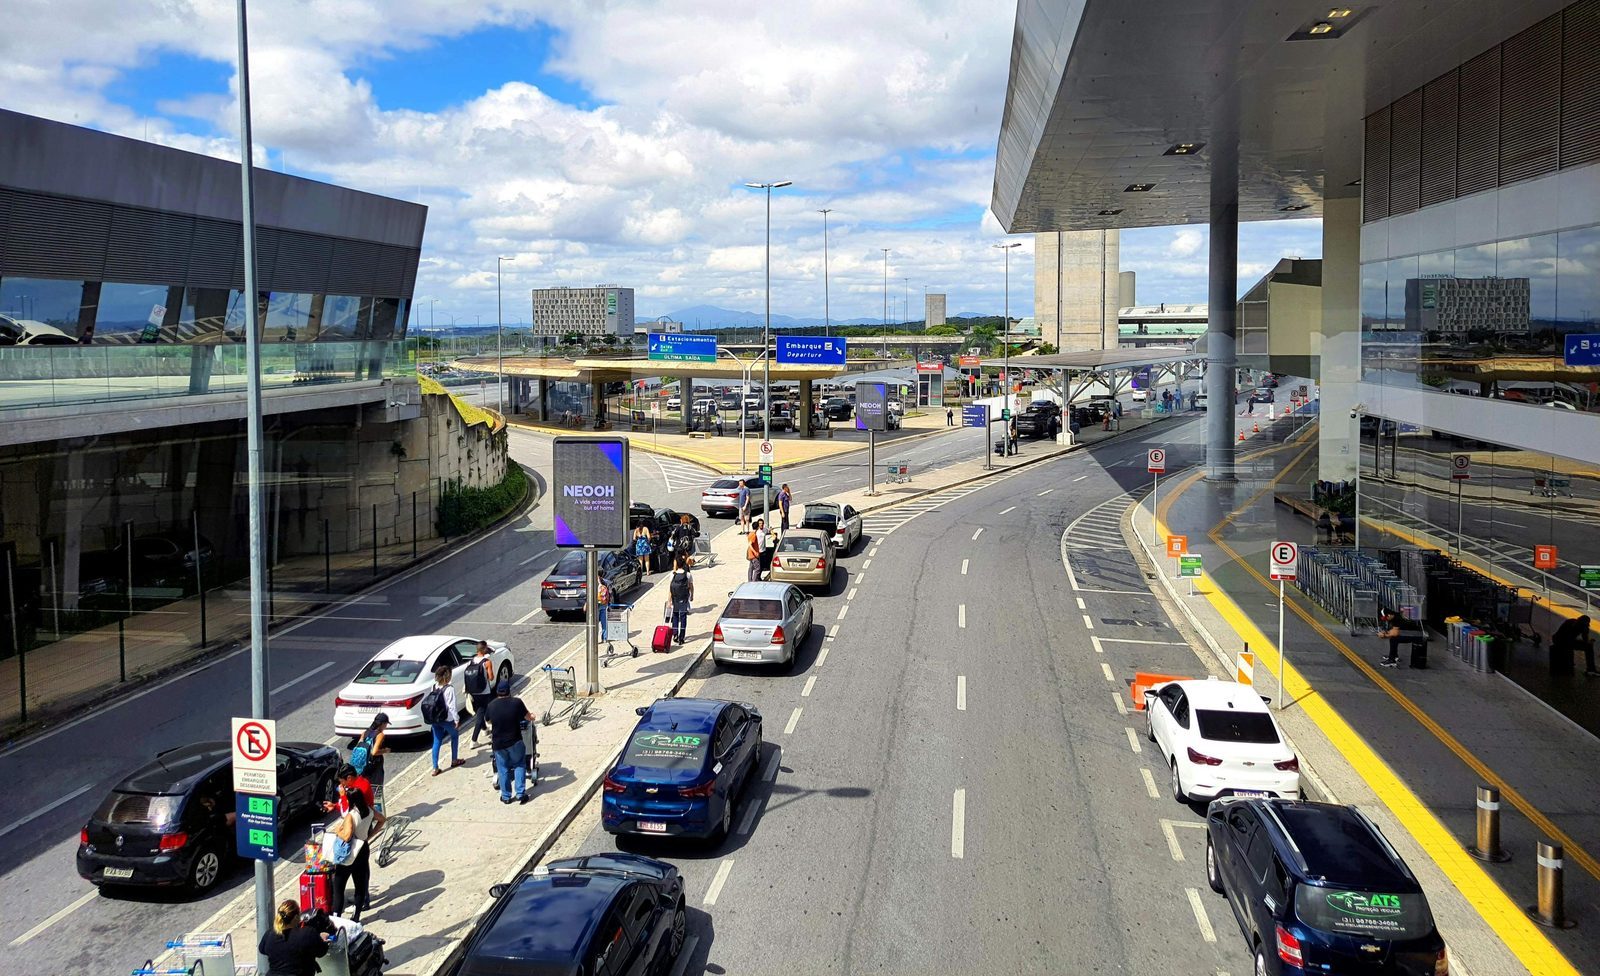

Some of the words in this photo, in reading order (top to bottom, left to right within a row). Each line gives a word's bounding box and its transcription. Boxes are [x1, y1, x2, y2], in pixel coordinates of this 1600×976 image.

[563, 485, 614, 497] NEOOH
[1280, 547, 1288, 560] E
[248, 730, 261, 754] E
[672, 736, 700, 745] ATS
[1370, 894, 1400, 907] ATS
